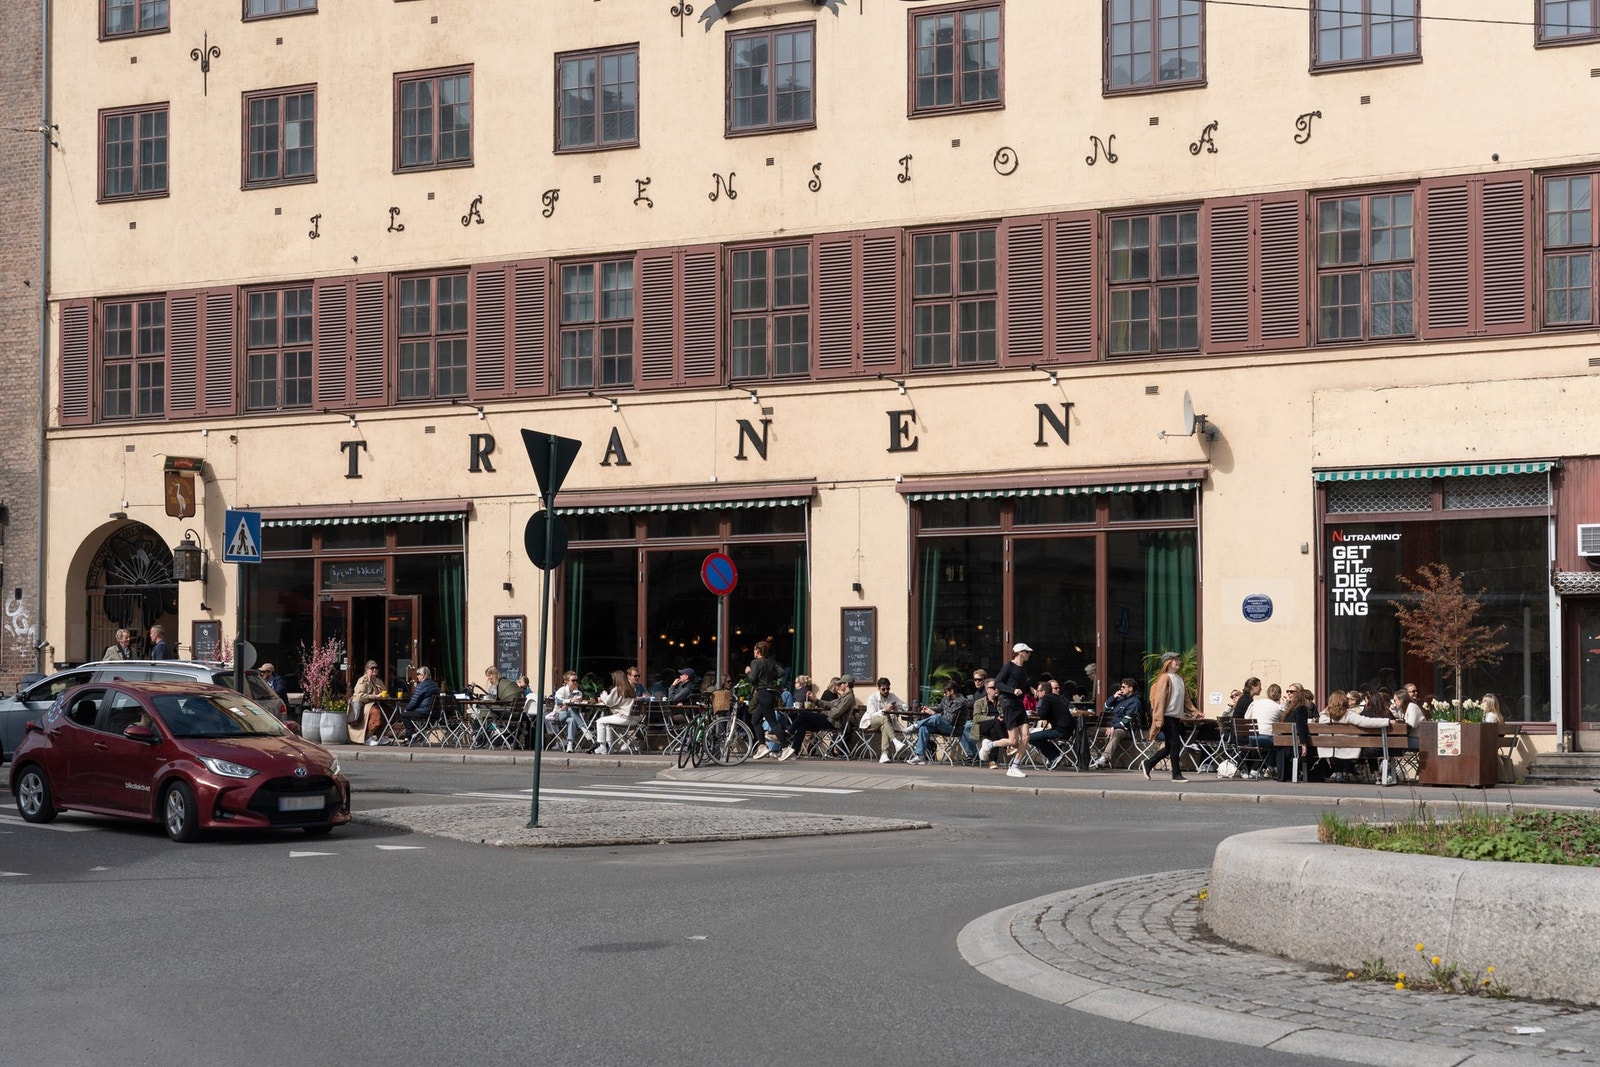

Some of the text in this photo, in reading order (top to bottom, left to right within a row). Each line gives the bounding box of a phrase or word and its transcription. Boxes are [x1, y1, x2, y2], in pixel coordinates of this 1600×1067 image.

[340, 402, 1074, 479] TRANEN
[1331, 529, 1401, 542] NUTRAMINO
[1332, 545, 1372, 560] GET
[356, 566, 383, 577] bakeri
[1334, 560, 1363, 574] FIT
[1335, 574, 1368, 588] DIE
[1331, 587, 1372, 602] TRY
[1334, 602, 1369, 616] ING
